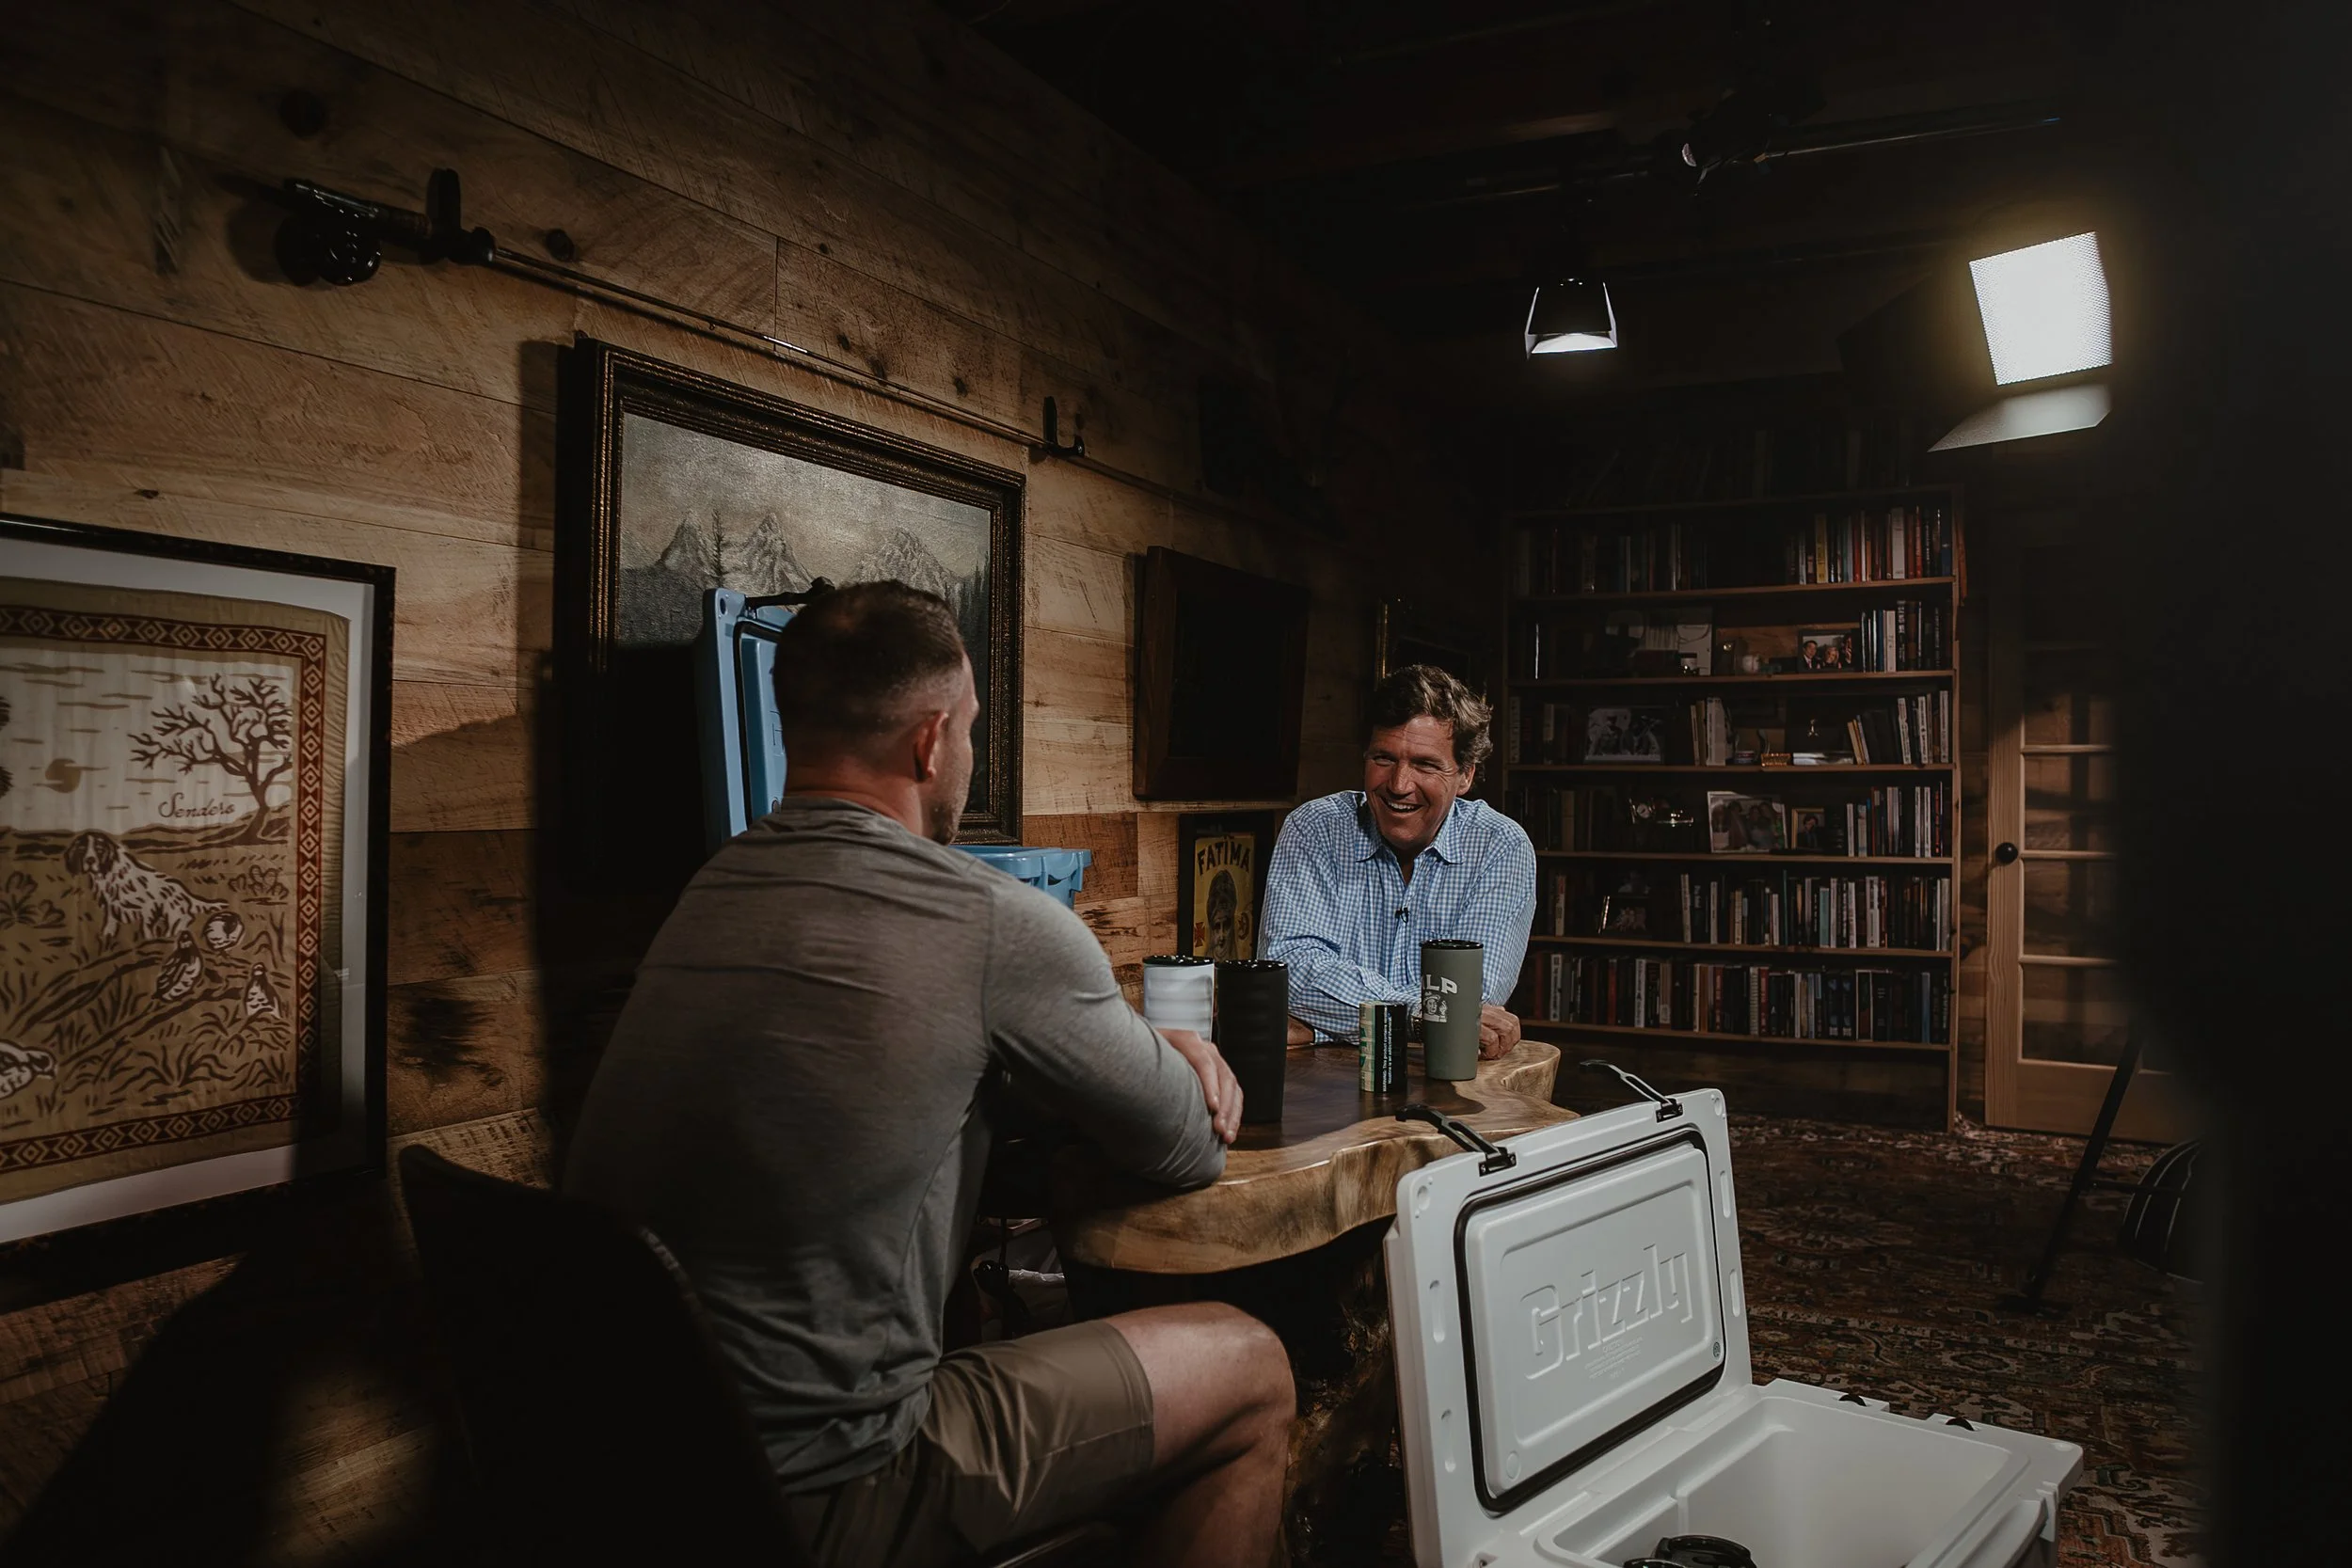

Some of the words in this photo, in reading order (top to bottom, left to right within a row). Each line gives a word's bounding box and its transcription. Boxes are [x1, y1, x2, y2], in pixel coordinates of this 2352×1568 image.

[158, 792, 235, 818] Sendero
[1197, 835, 1251, 876] FATIMA
[1422, 974, 1458, 994] LP
[1519, 1243, 1692, 1380] Grizzly
